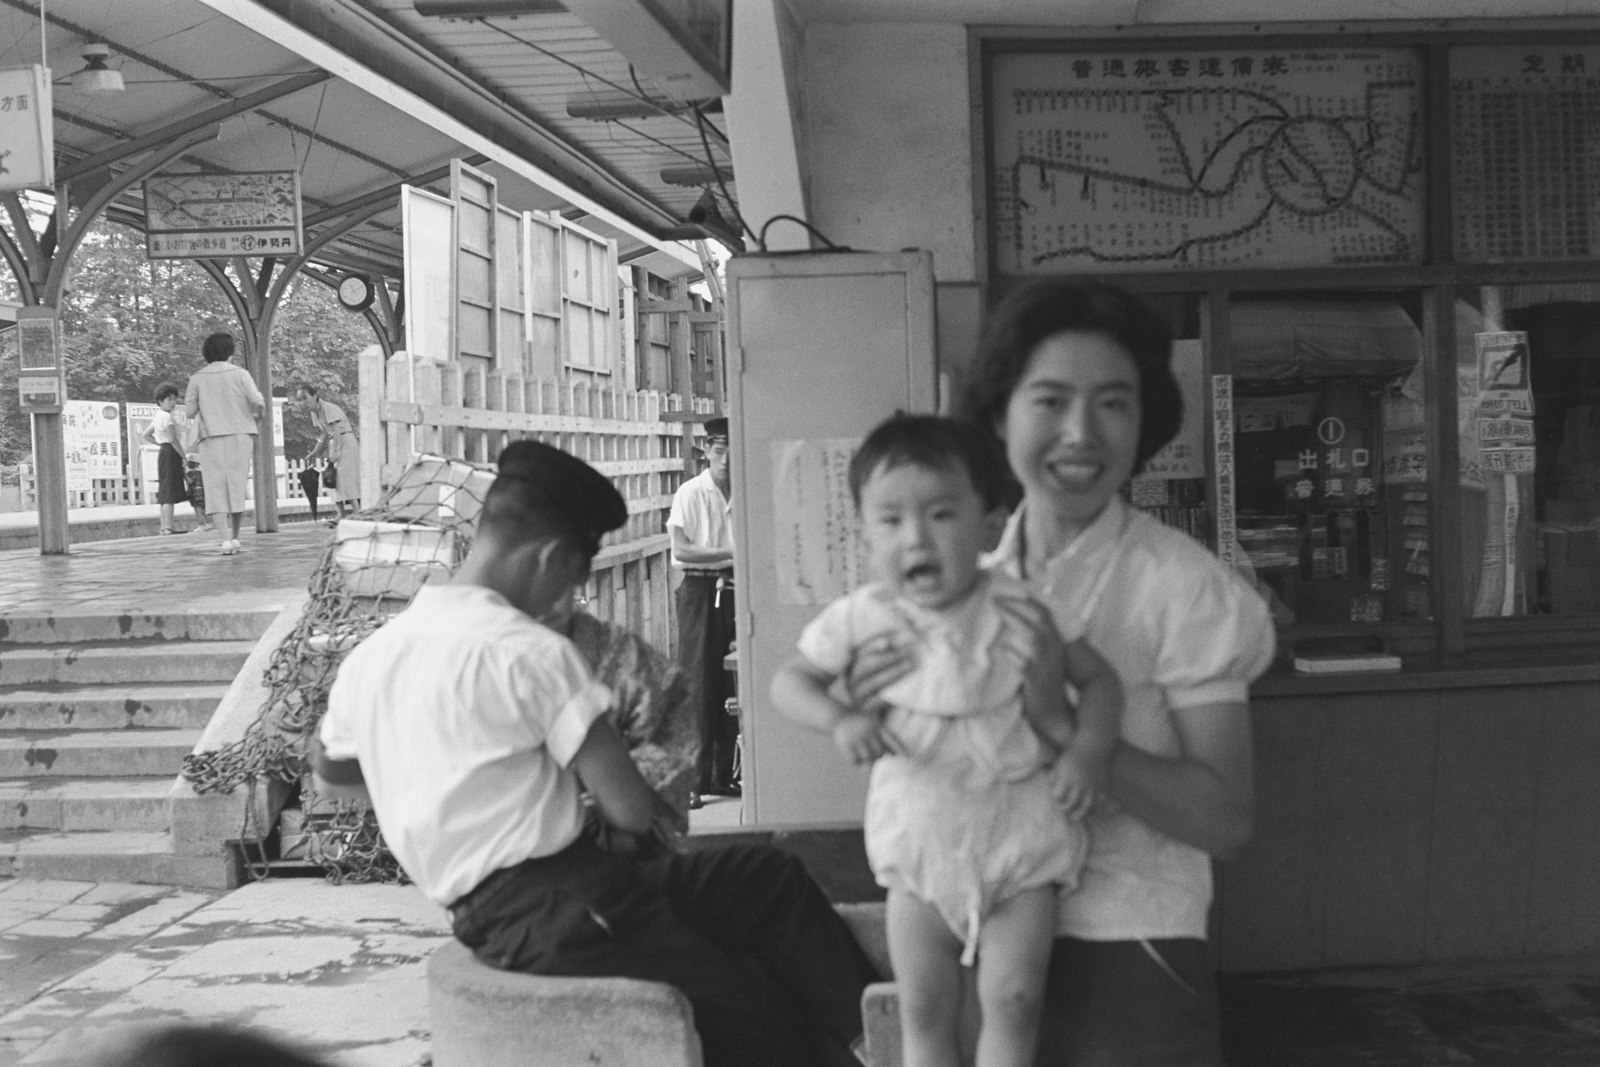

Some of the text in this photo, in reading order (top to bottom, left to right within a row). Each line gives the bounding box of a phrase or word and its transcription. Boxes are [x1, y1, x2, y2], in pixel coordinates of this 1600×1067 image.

[1, 95, 29, 112] 方面
[1298, 448, 1370, 470] 出札口
